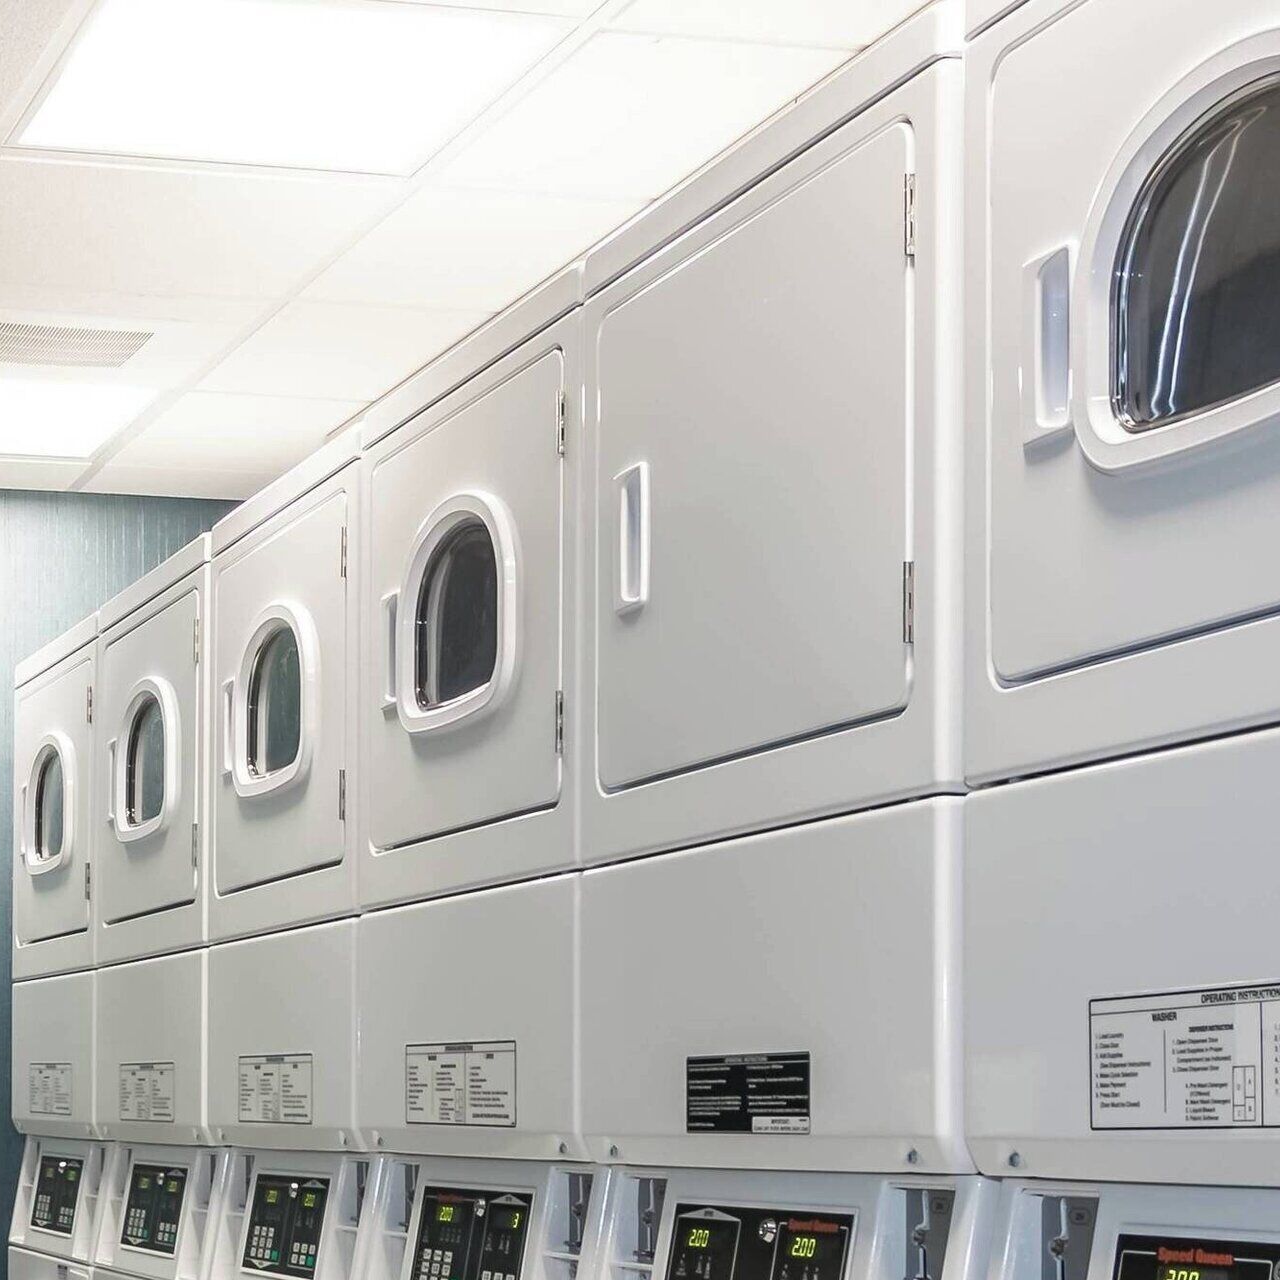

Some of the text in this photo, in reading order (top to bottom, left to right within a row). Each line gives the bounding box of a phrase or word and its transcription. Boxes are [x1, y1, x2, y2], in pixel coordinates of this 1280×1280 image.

[1201, 992, 1236, 1003] OPERATING
[1152, 1011, 1177, 1021] WASHER
[791, 1237, 816, 1258] 2.00
